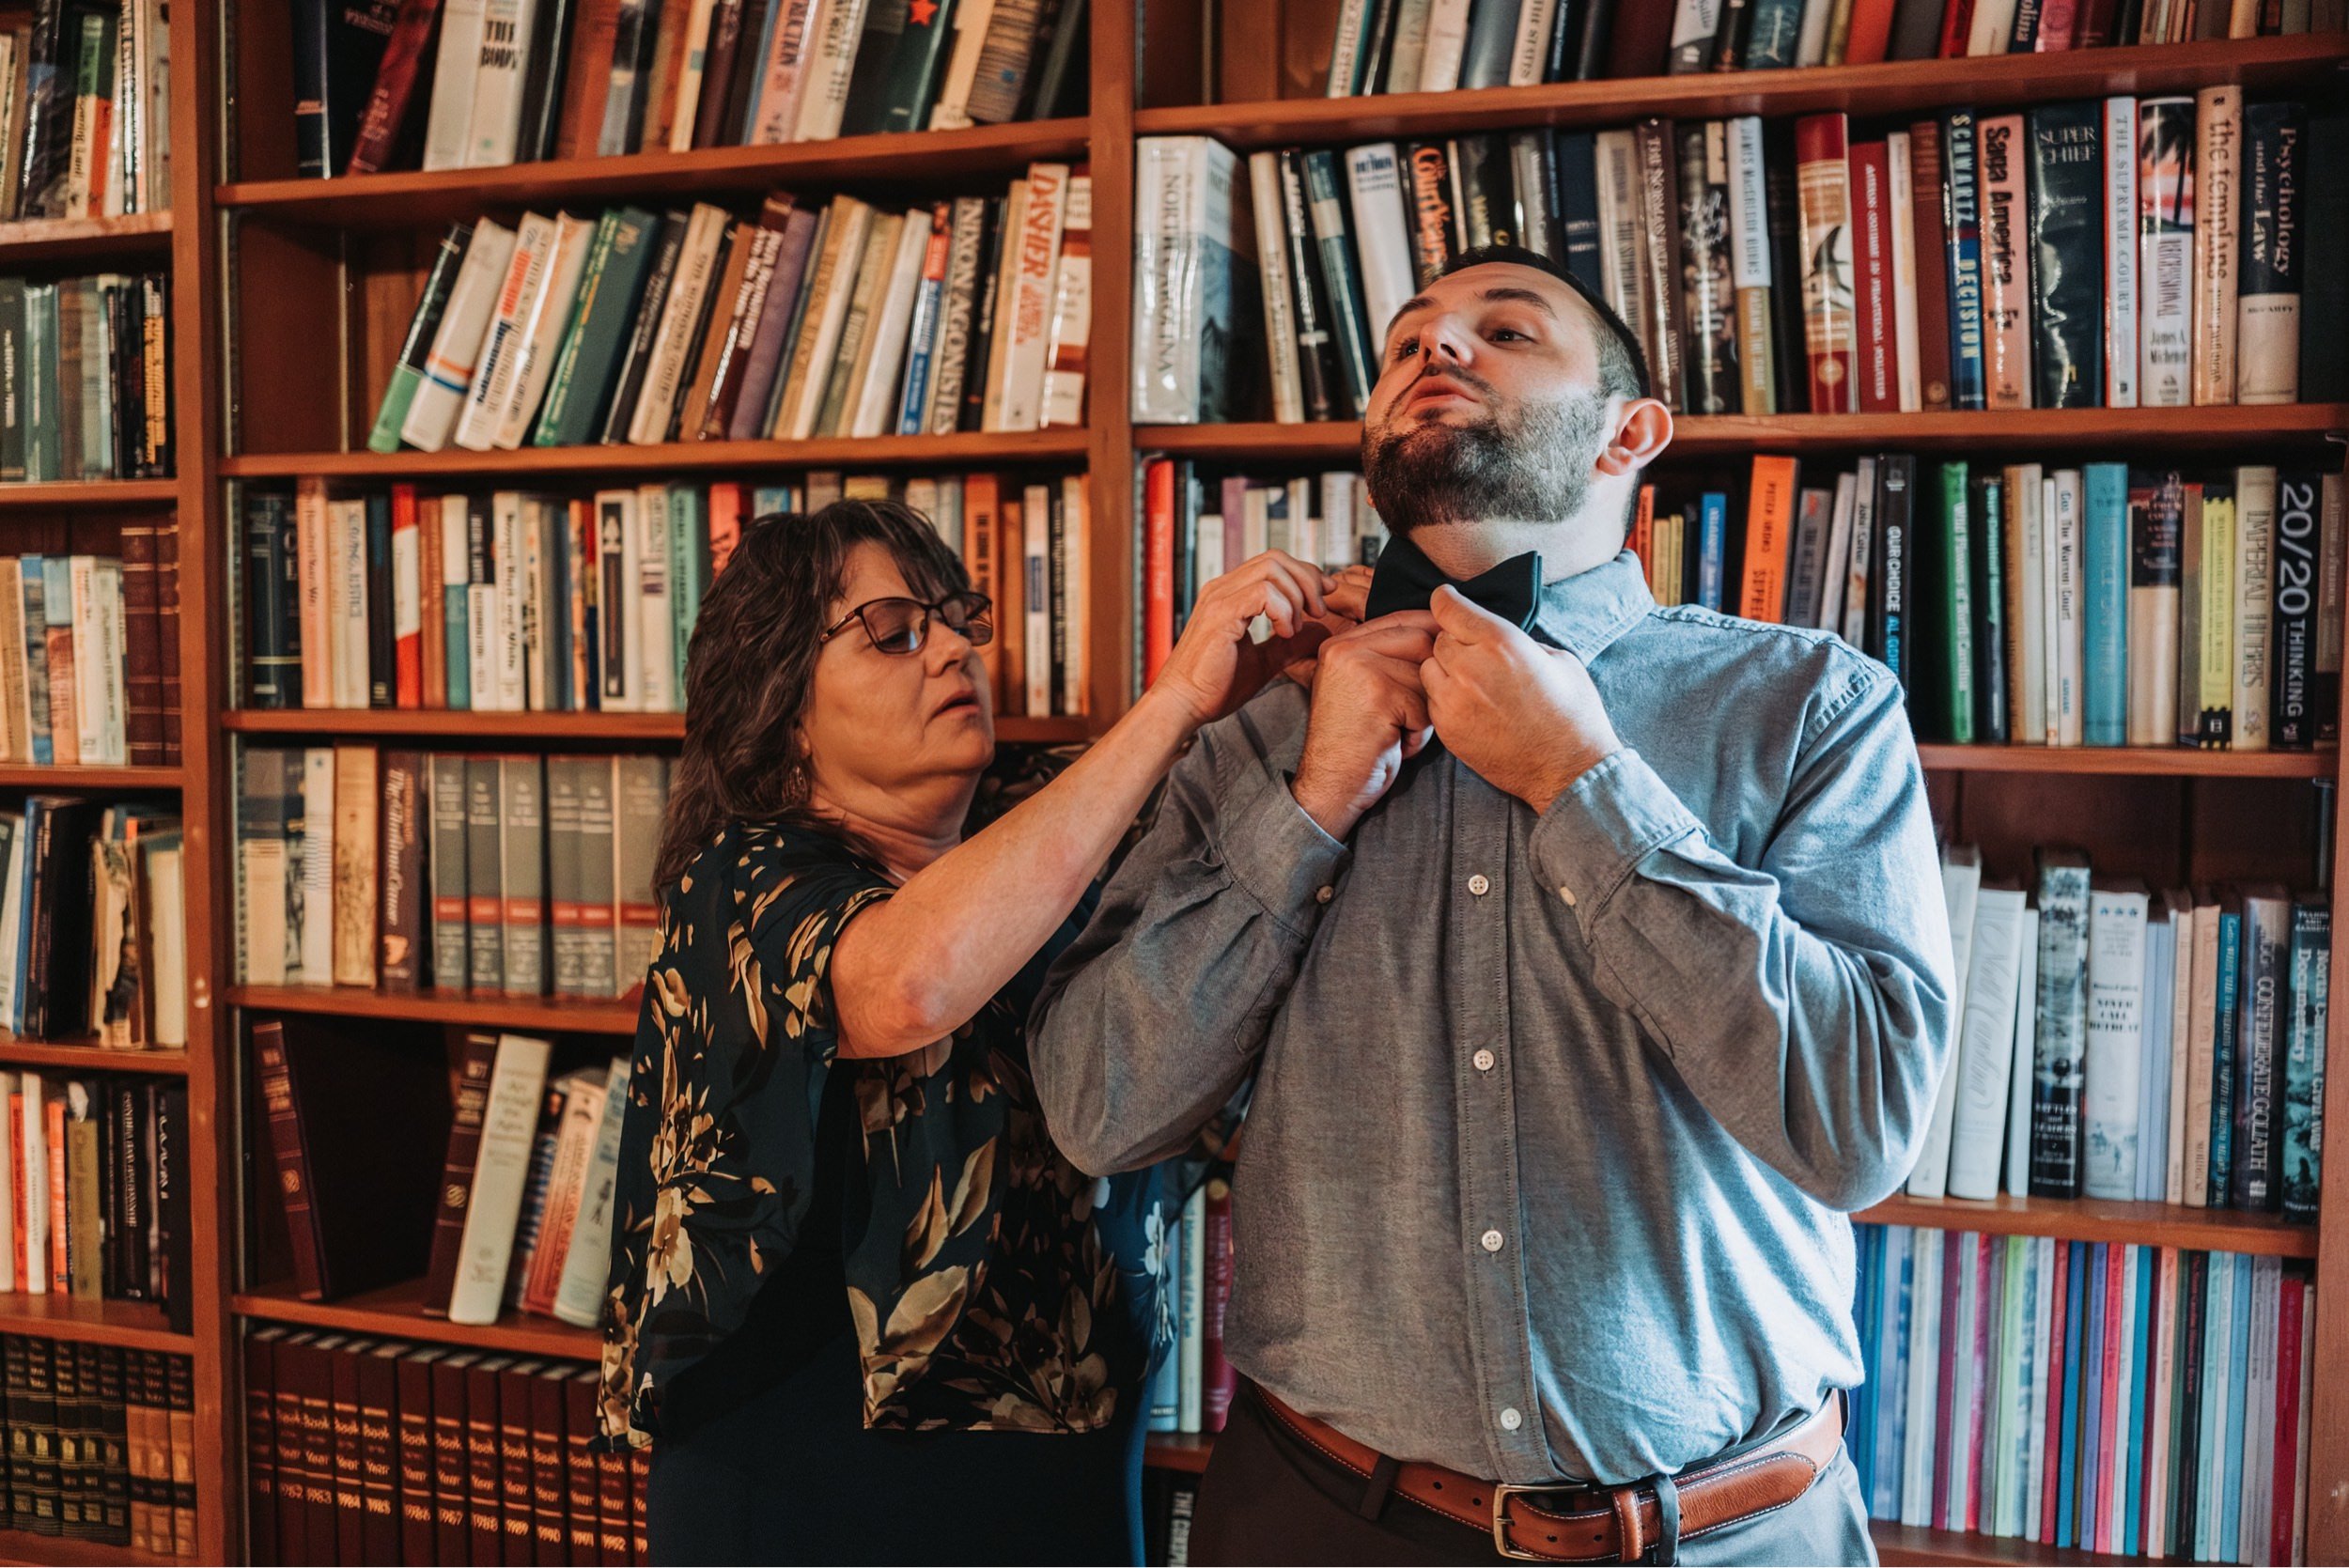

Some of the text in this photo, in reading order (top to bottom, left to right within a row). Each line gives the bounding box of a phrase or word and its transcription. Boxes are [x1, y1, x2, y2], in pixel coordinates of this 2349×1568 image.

[1741, 128, 1755, 164] JAMES
[1952, 113, 1975, 225] SCHWARTZ
[2040, 128, 2095, 145] SUPER
[2041, 145, 2095, 165] CHIEF
[2209, 118, 2234, 160] the
[1023, 173, 1059, 279] DASHER
[1162, 174, 1180, 251] NORTH
[1648, 168, 1666, 237] NORMAN
[1984, 126, 2016, 286] Saga America
[2115, 115, 2130, 316] THE SUPREME COURT
[2203, 167, 2234, 281] templars
[2253, 210, 2271, 264] Law
[2273, 128, 2297, 277] Psychology
[1745, 239, 1761, 275] BURNS
[932, 199, 985, 437] NIXON AGONISTES
[1958, 258, 1981, 359] DECISION
[1886, 558, 1902, 613] CHOICE
[2061, 490, 2073, 621] Cox The Warren Court
[2242, 510, 2272, 688] IMPERIAL HUBRIS
[2279, 482, 2314, 718] 20/20 THINKING
[2290, 948, 2312, 1063] Documentary
[2315, 948, 2330, 999] North
[2253, 976, 2275, 1096] CONFEDERATE
[2312, 1001, 2327, 1074] Carolina
[2250, 1097, 2271, 1171] GOLIATH
[2310, 1077, 2325, 1116] Civil
